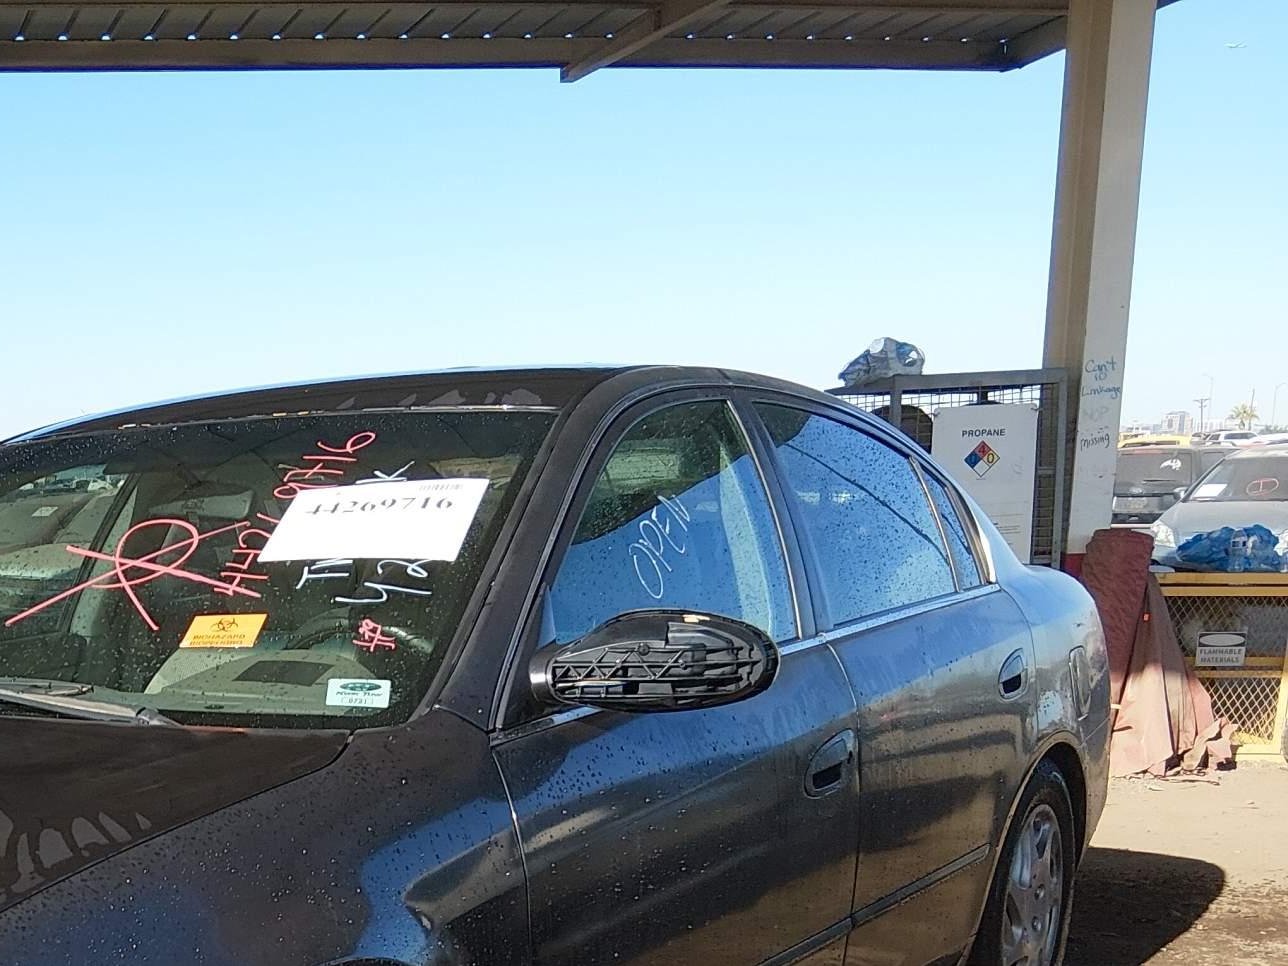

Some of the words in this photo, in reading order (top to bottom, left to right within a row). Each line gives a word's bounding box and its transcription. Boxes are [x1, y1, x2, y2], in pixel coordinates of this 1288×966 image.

[961, 428, 1006, 438] PROPANE
[978, 444, 986, 454] 4
[986, 453, 995, 464] 0
[305, 496, 454, 515] 44269716
